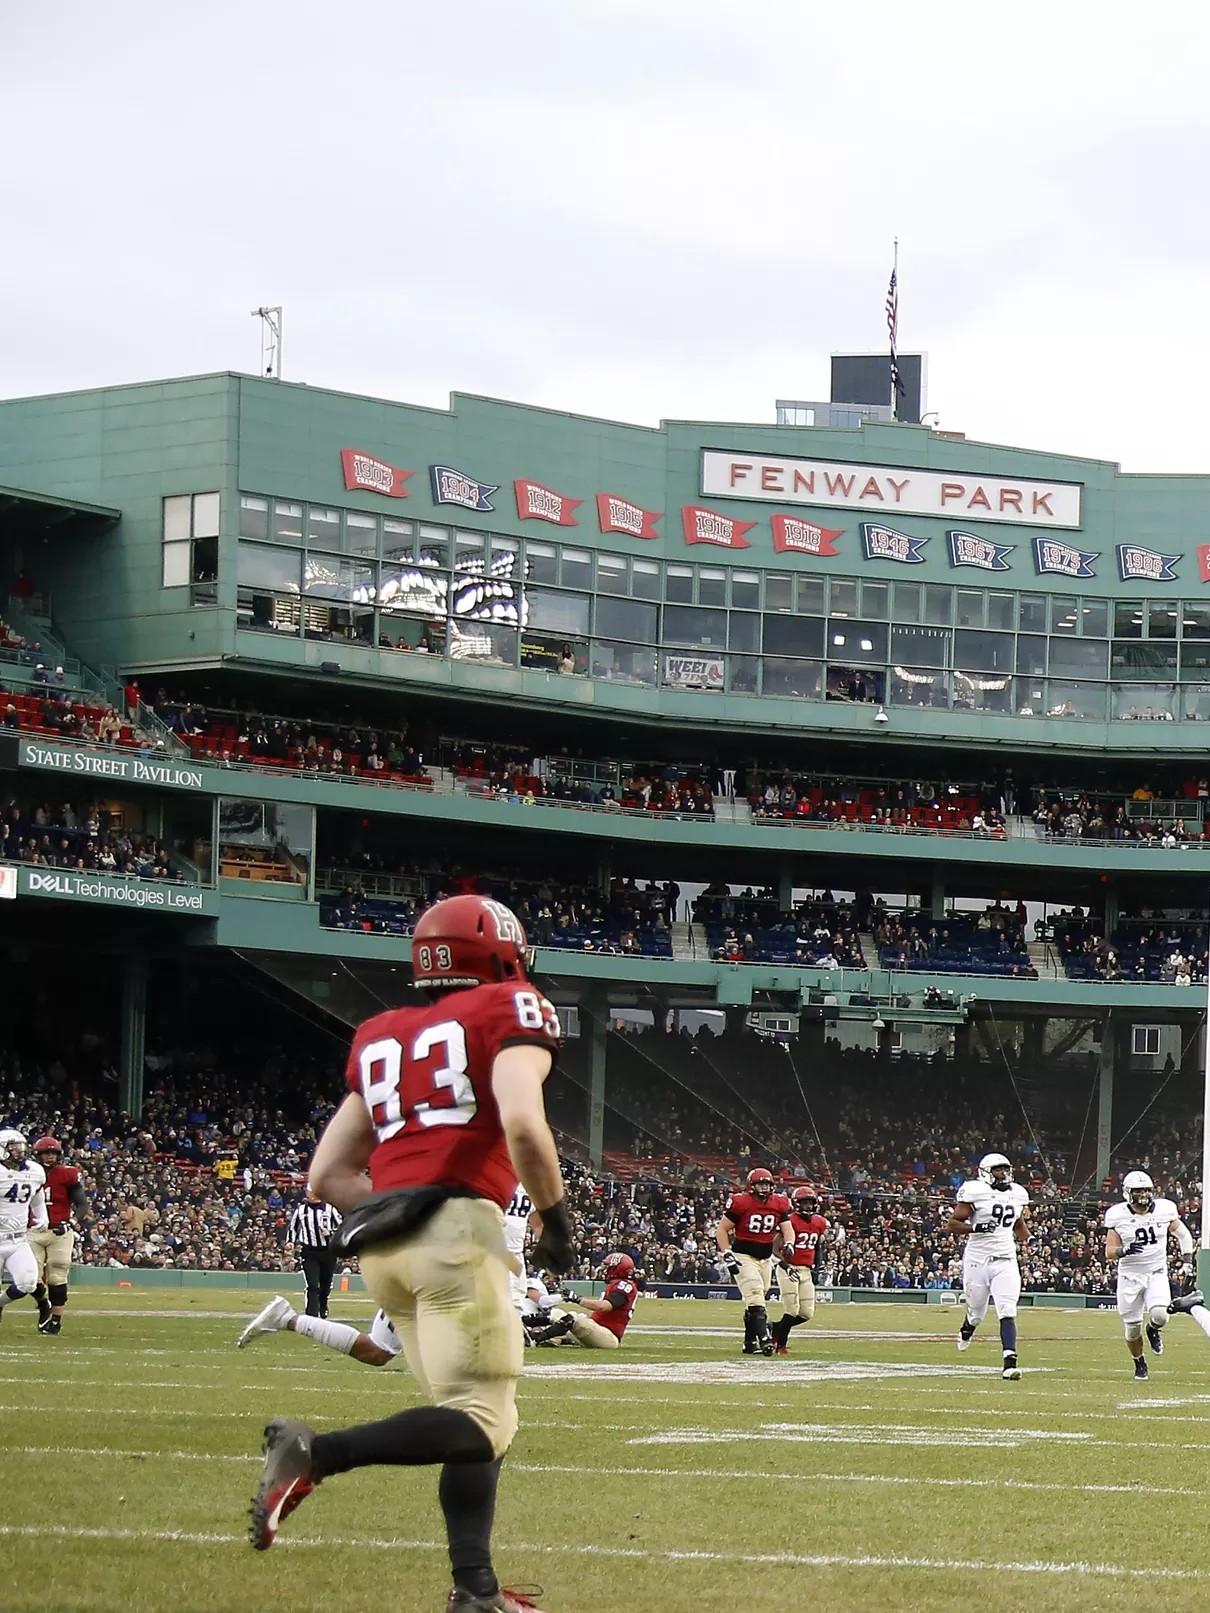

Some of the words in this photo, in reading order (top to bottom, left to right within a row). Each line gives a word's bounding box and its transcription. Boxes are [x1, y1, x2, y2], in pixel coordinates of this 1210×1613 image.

[354, 461, 393, 487] 1903
[356, 477, 390, 492] CHAMPIONS
[441, 476, 479, 502] 1904
[730, 463, 910, 502] FENWAY
[941, 482, 1054, 516] PARK
[444, 492, 477, 508] CHAMPIONS
[528, 491, 562, 516] 1912
[529, 506, 560, 521] CHAMPIONS
[610, 504, 643, 529] 1915
[610, 520, 641, 534] CHAMPIONS
[696, 516, 733, 539] 1916
[785, 524, 820, 547] 1918
[697, 532, 731, 544] CHAMPIONS
[786, 539, 819, 552] CHAMPIONS
[871, 532, 909, 555] 1946
[873, 548, 906, 560] CHAMPIONS
[958, 540, 995, 561] 1967
[1043, 547, 1081, 569] 1975
[960, 555, 993, 568] CHAMPIONS
[1046, 562, 1077, 574] CHAMPIONS
[1126, 553, 1163, 573] 1986
[1129, 568, 1160, 578] CHAMPIONS
[669, 660, 707, 673] WEEI
[26, 745, 71, 768] STATE
[74, 753, 128, 776] STREET
[133, 761, 202, 787] PAVILION
[29, 872, 74, 894] DELL
[74, 878, 164, 906] Technologies
[168, 889, 203, 909] Level
[420, 945, 452, 970] 83
[514, 991, 561, 1038] 83
[359, 1020, 478, 1143] 83
[4, 1183, 32, 1203] 43
[508, 1194, 531, 1218] 18
[992, 1203, 1015, 1228] 92
[749, 1214, 775, 1234] 69
[796, 1232, 818, 1249] 20
[1135, 1226, 1158, 1245] 91
[617, 1280, 633, 1294] 58
